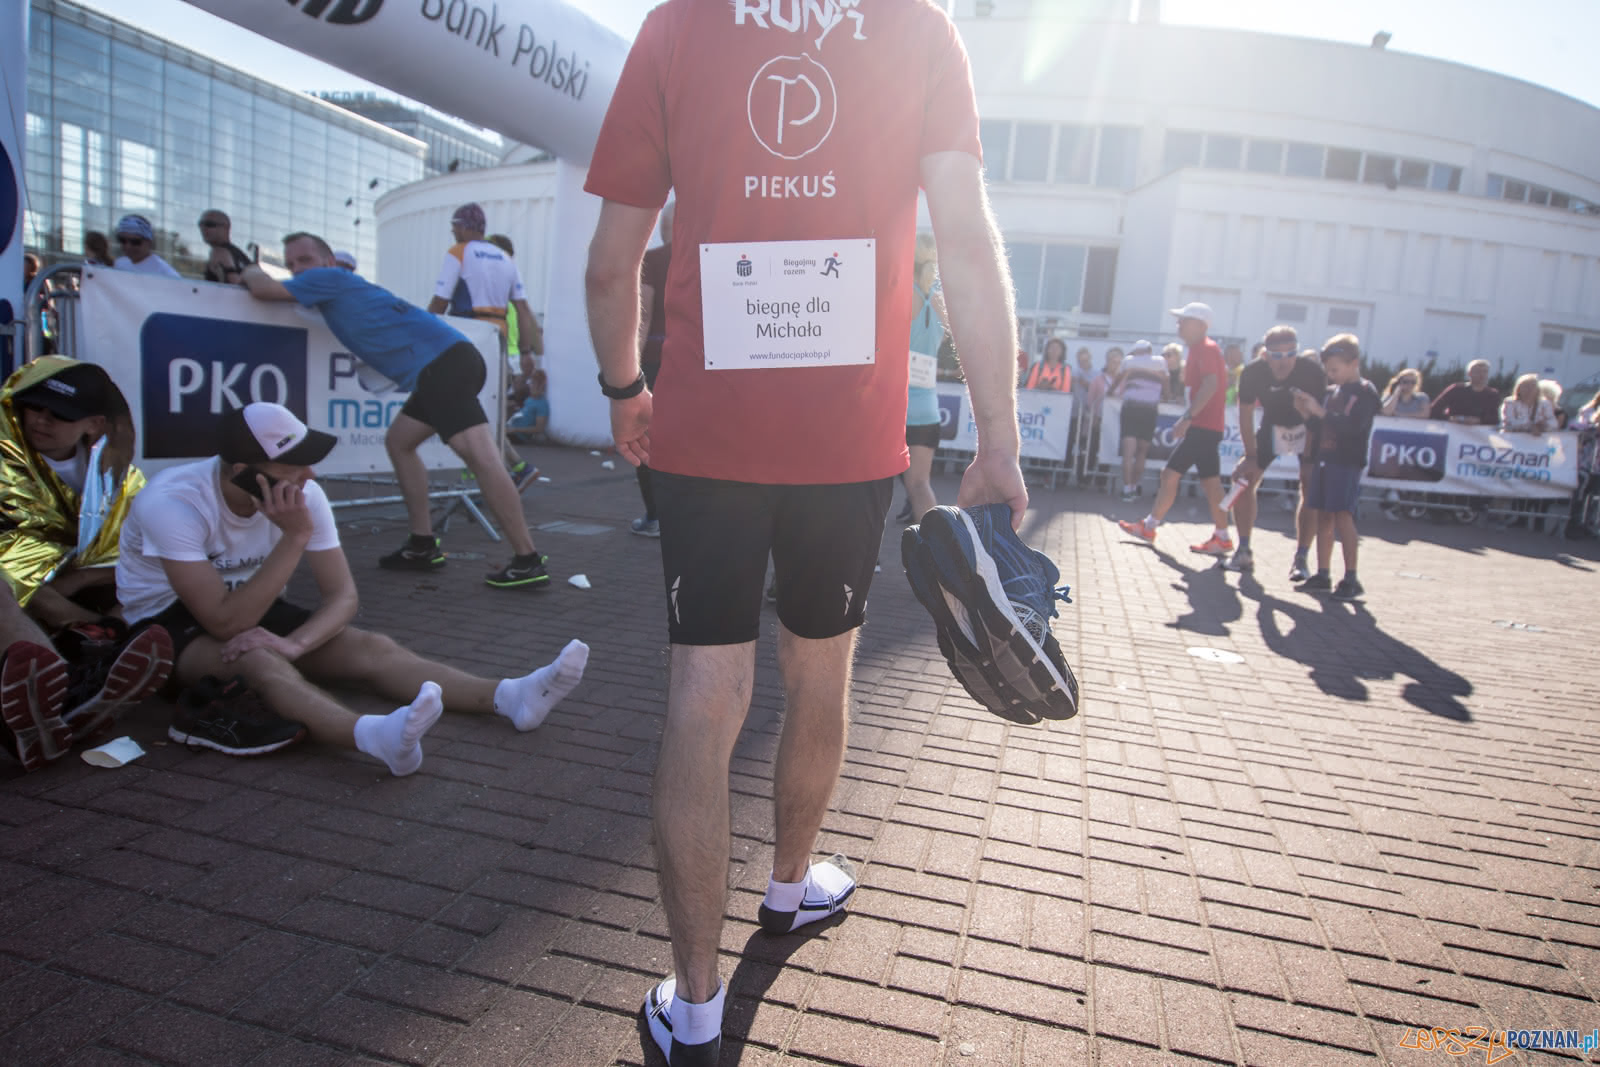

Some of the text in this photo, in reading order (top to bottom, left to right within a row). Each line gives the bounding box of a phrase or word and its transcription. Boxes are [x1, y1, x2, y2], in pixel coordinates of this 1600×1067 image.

[511, 23, 591, 101] Polski
[744, 170, 836, 198] PIEKUŚ
[783, 258, 816, 267] Biegajmy
[746, 296, 830, 319] biegnę dla
[756, 321, 822, 339] Michała
[749, 349, 831, 361] www.fundacjapkobp.pl
[169, 358, 288, 414] PKO
[1379, 442, 1437, 468] PKO
[1456, 462, 1552, 482] maraton
